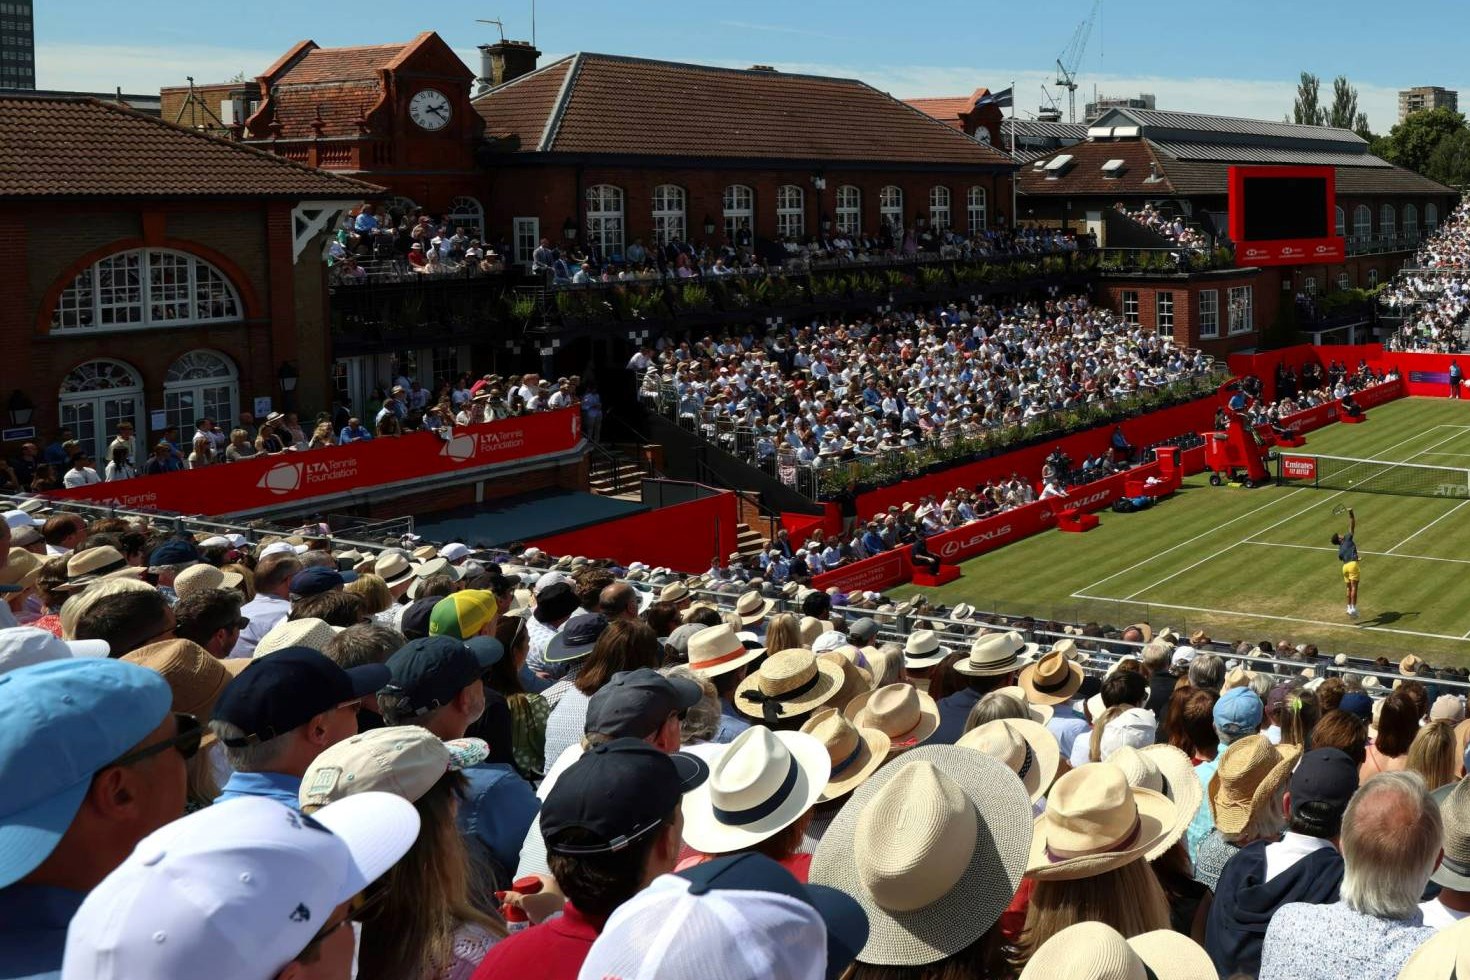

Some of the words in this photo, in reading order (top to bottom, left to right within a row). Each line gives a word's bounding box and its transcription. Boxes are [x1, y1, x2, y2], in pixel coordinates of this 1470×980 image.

[480, 433, 499, 444] LTA
[498, 429, 524, 442] Tennis
[480, 438, 524, 452] Foundation
[307, 462, 329, 473] LTA
[328, 458, 357, 470] Tennis
[1285, 460, 1313, 470] Emirates
[307, 468, 358, 484] Foundation
[1433, 483, 1468, 496] ATP
[121, 491, 157, 506] Tennis
[1060, 489, 1111, 511] UNLOP
[960, 525, 1012, 549] LEXUS
